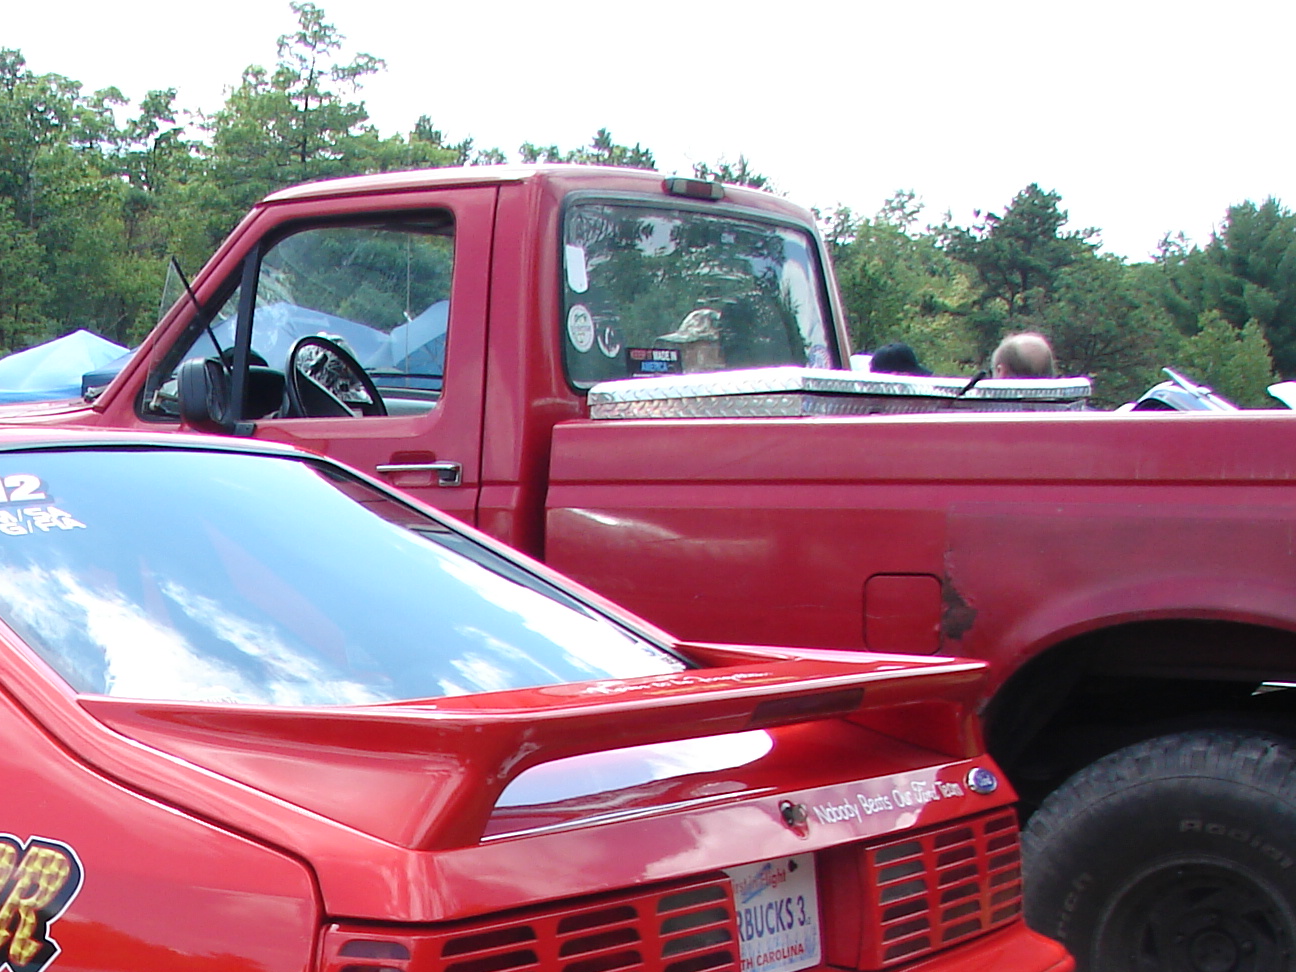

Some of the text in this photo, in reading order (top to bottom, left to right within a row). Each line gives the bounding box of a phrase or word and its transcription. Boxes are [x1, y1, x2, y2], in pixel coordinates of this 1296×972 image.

[813, 797, 862, 824] Nobody
[857, 794, 893, 815] Beats
[911, 781, 941, 804] Ford
[935, 780, 964, 799] Team
[797, 895, 806, 926] 3
[756, 943, 805, 966] CAROLINA
